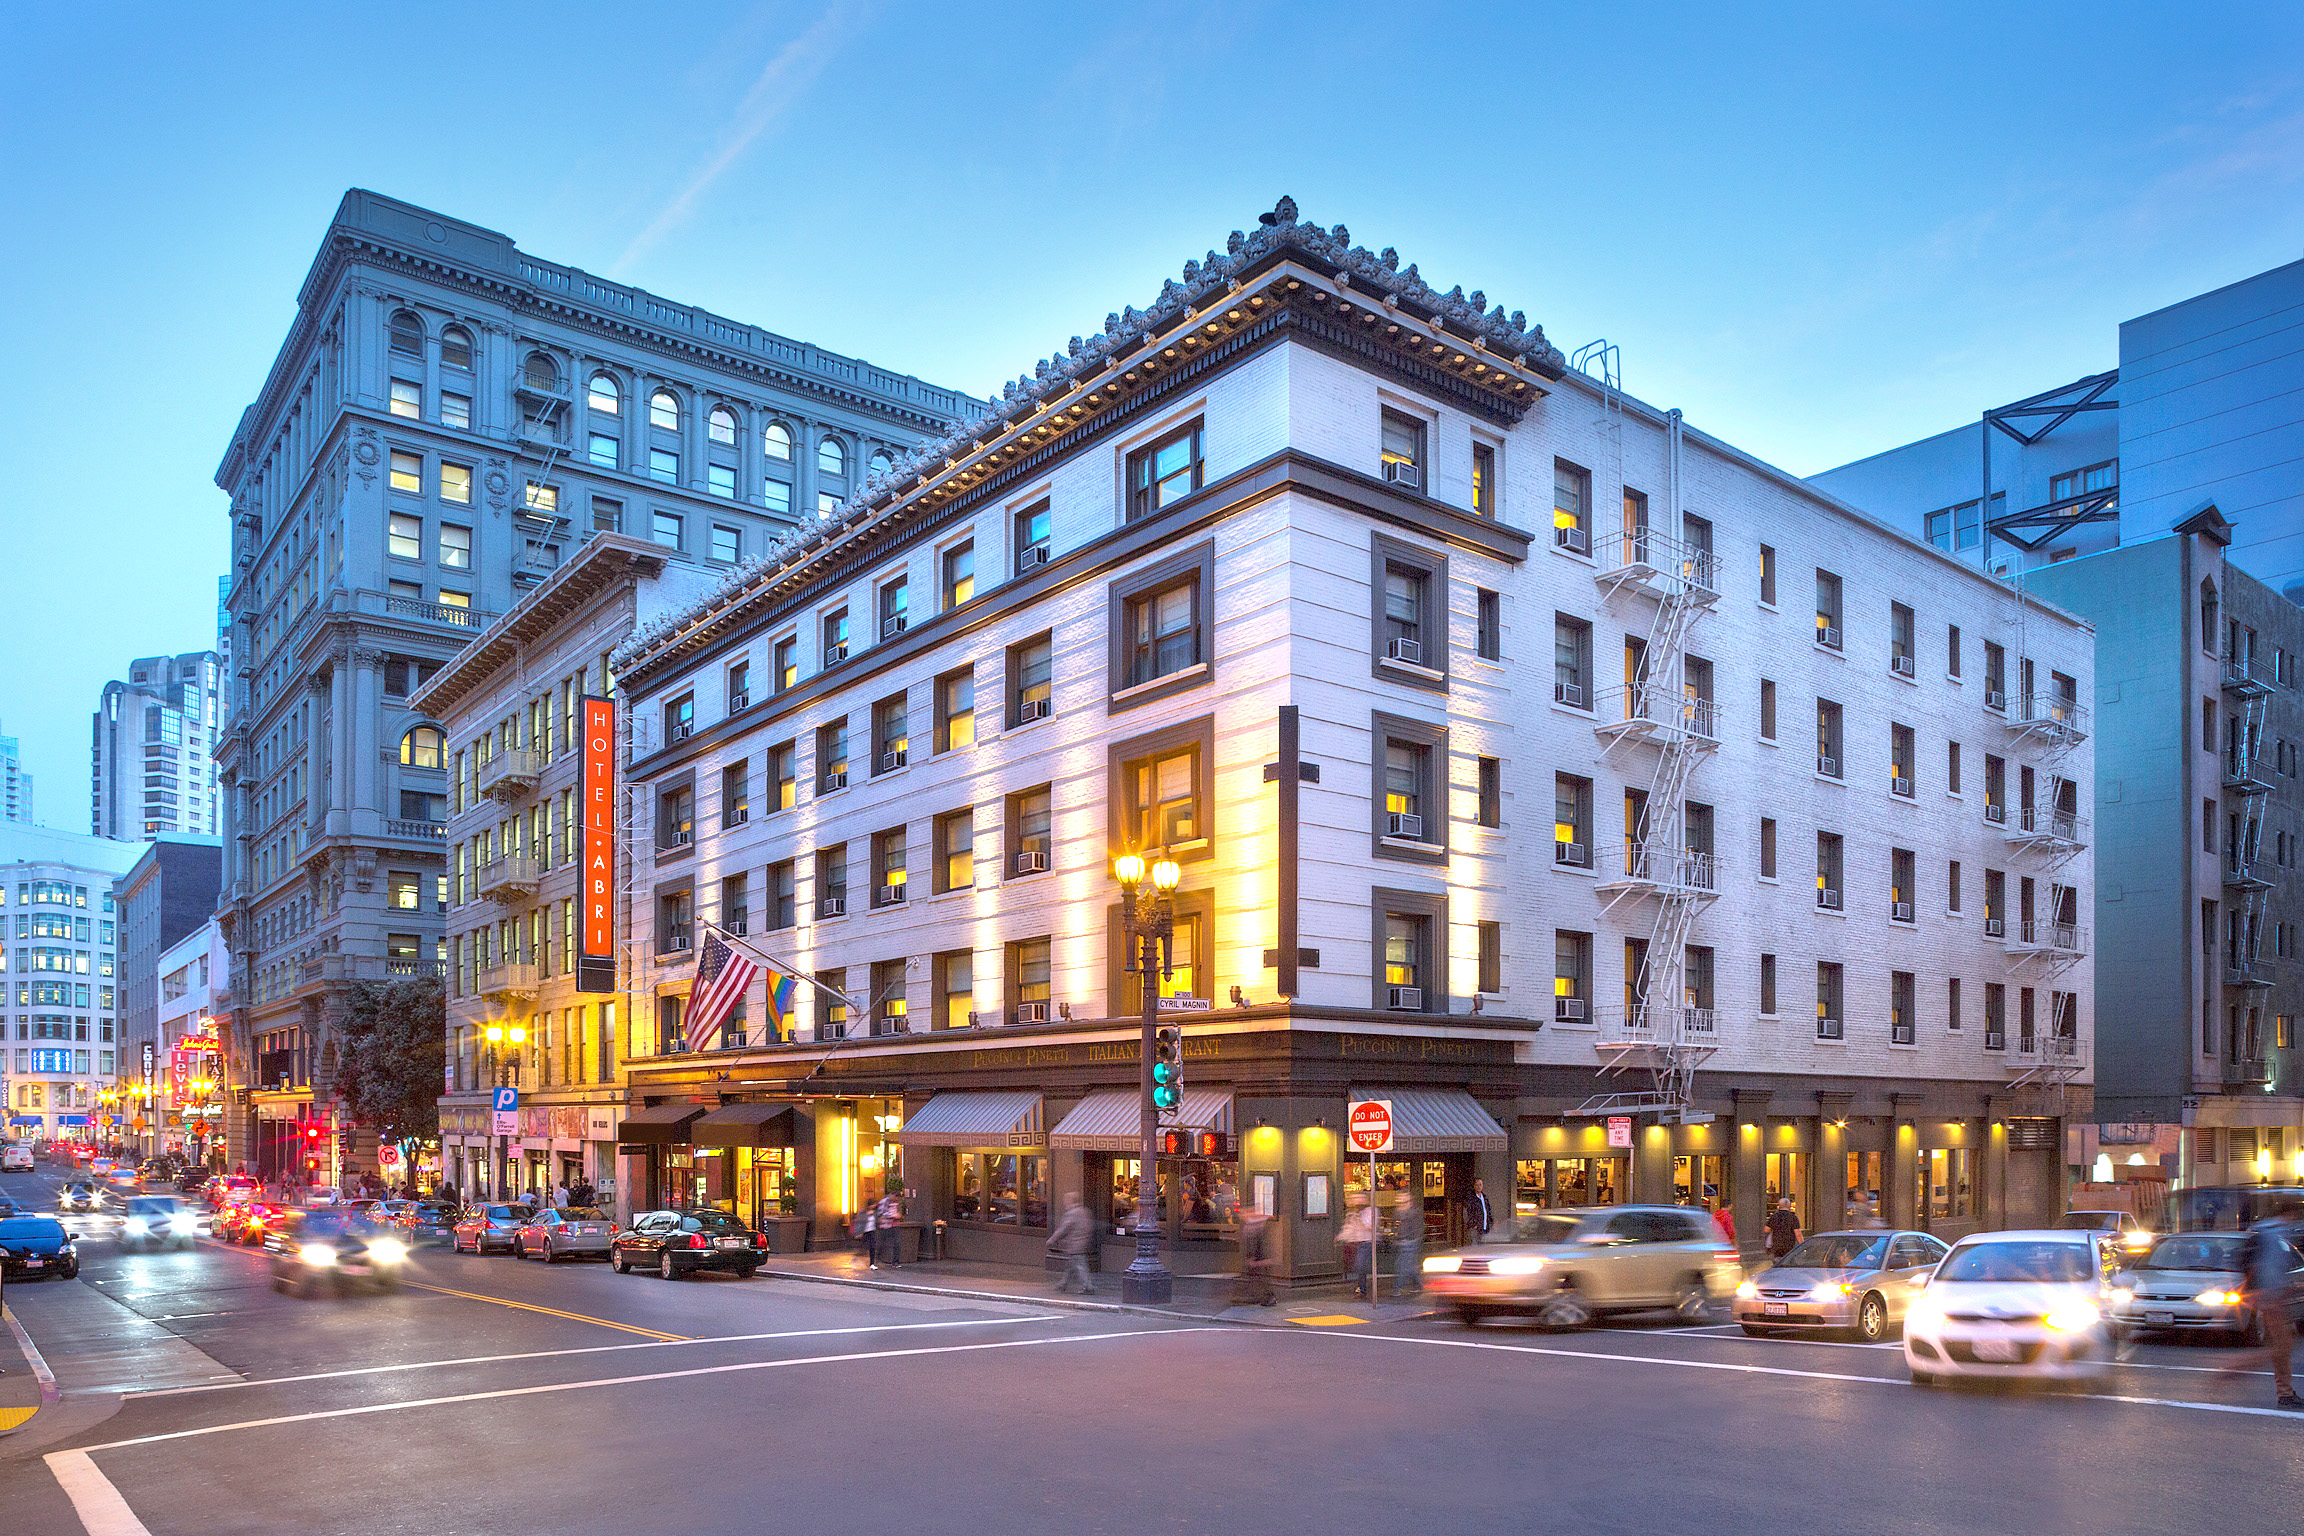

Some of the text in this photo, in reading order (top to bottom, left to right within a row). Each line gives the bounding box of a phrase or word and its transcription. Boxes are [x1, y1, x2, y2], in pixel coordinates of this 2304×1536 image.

[593, 712, 607, 945] HOTEL ABRI
[1160, 1000, 1208, 1009] CYRIL MAGNIN
[1089, 1045, 1135, 1060] ITALIAN
[1340, 1034, 1400, 1056] PUCCINI
[1420, 1037, 1475, 1059] PINETTI
[1026, 1048, 1069, 1066] PINETTI
[1355, 1110, 1385, 1120] DO NOT
[1358, 1132, 1382, 1142] ENTER
